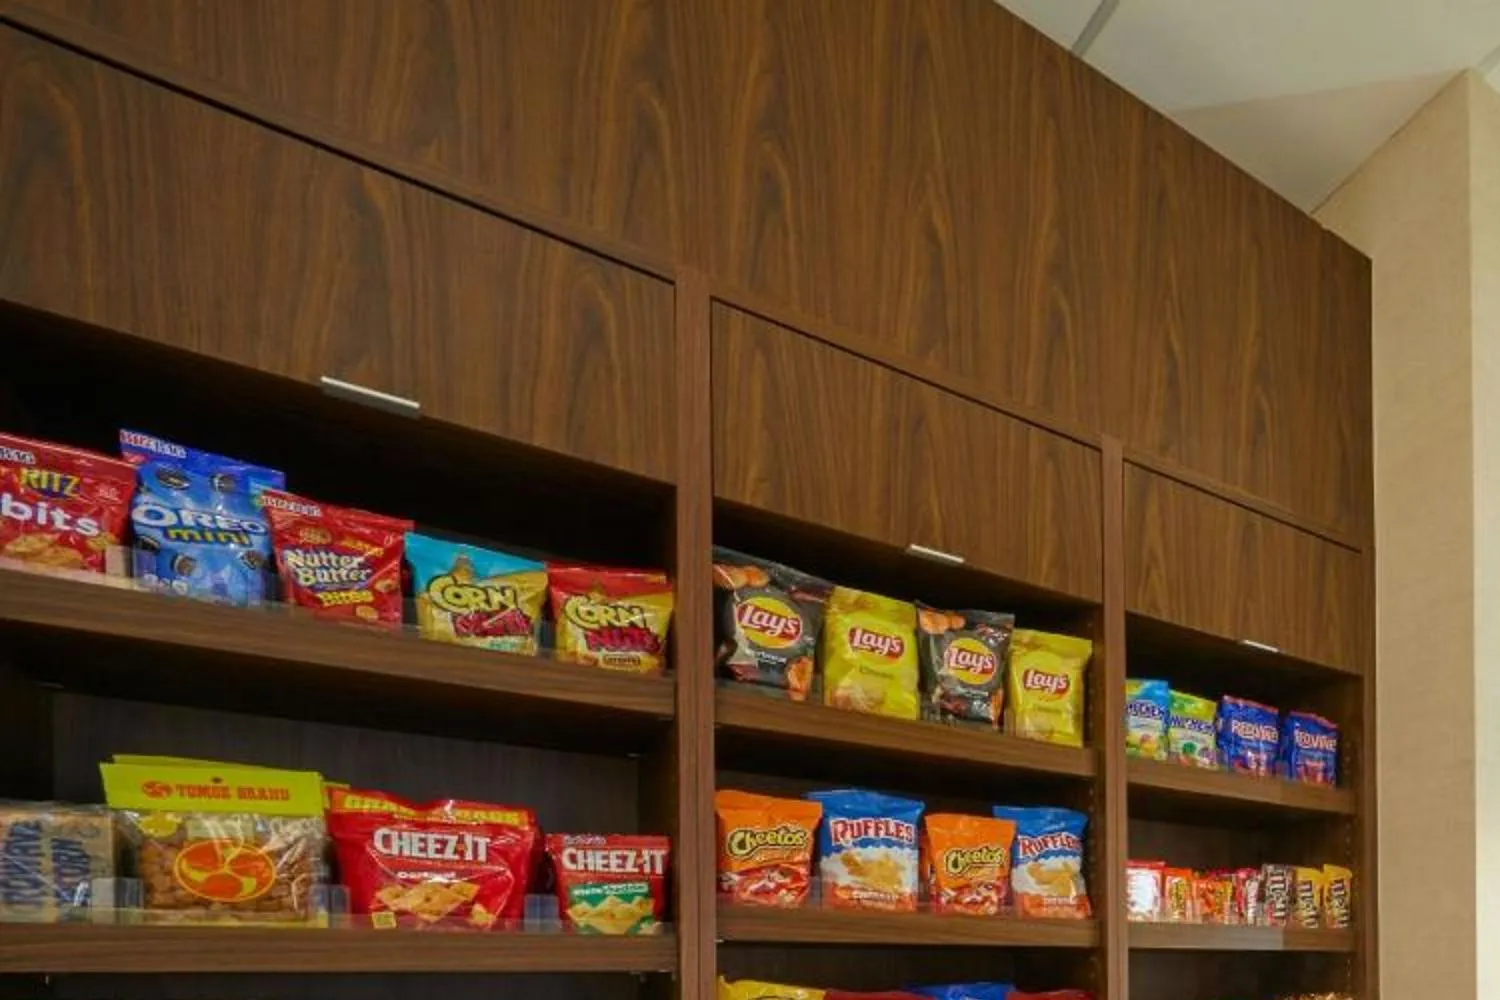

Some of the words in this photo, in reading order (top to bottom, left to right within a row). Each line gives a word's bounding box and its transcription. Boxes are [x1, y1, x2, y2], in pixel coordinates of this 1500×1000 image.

[20, 466, 81, 498] RITZ
[1, 493, 99, 537] bits
[131, 503, 267, 535] OREO
[166, 527, 249, 547] mini
[740, 603, 800, 637] Lay's
[852, 626, 903, 657] Lay's
[949, 647, 994, 674] Lay's
[1025, 669, 1069, 694] Lay's
[726, 824, 808, 858] Cheetos
[830, 817, 915, 847] RUFFLES
[944, 845, 1004, 877] Cheetos
